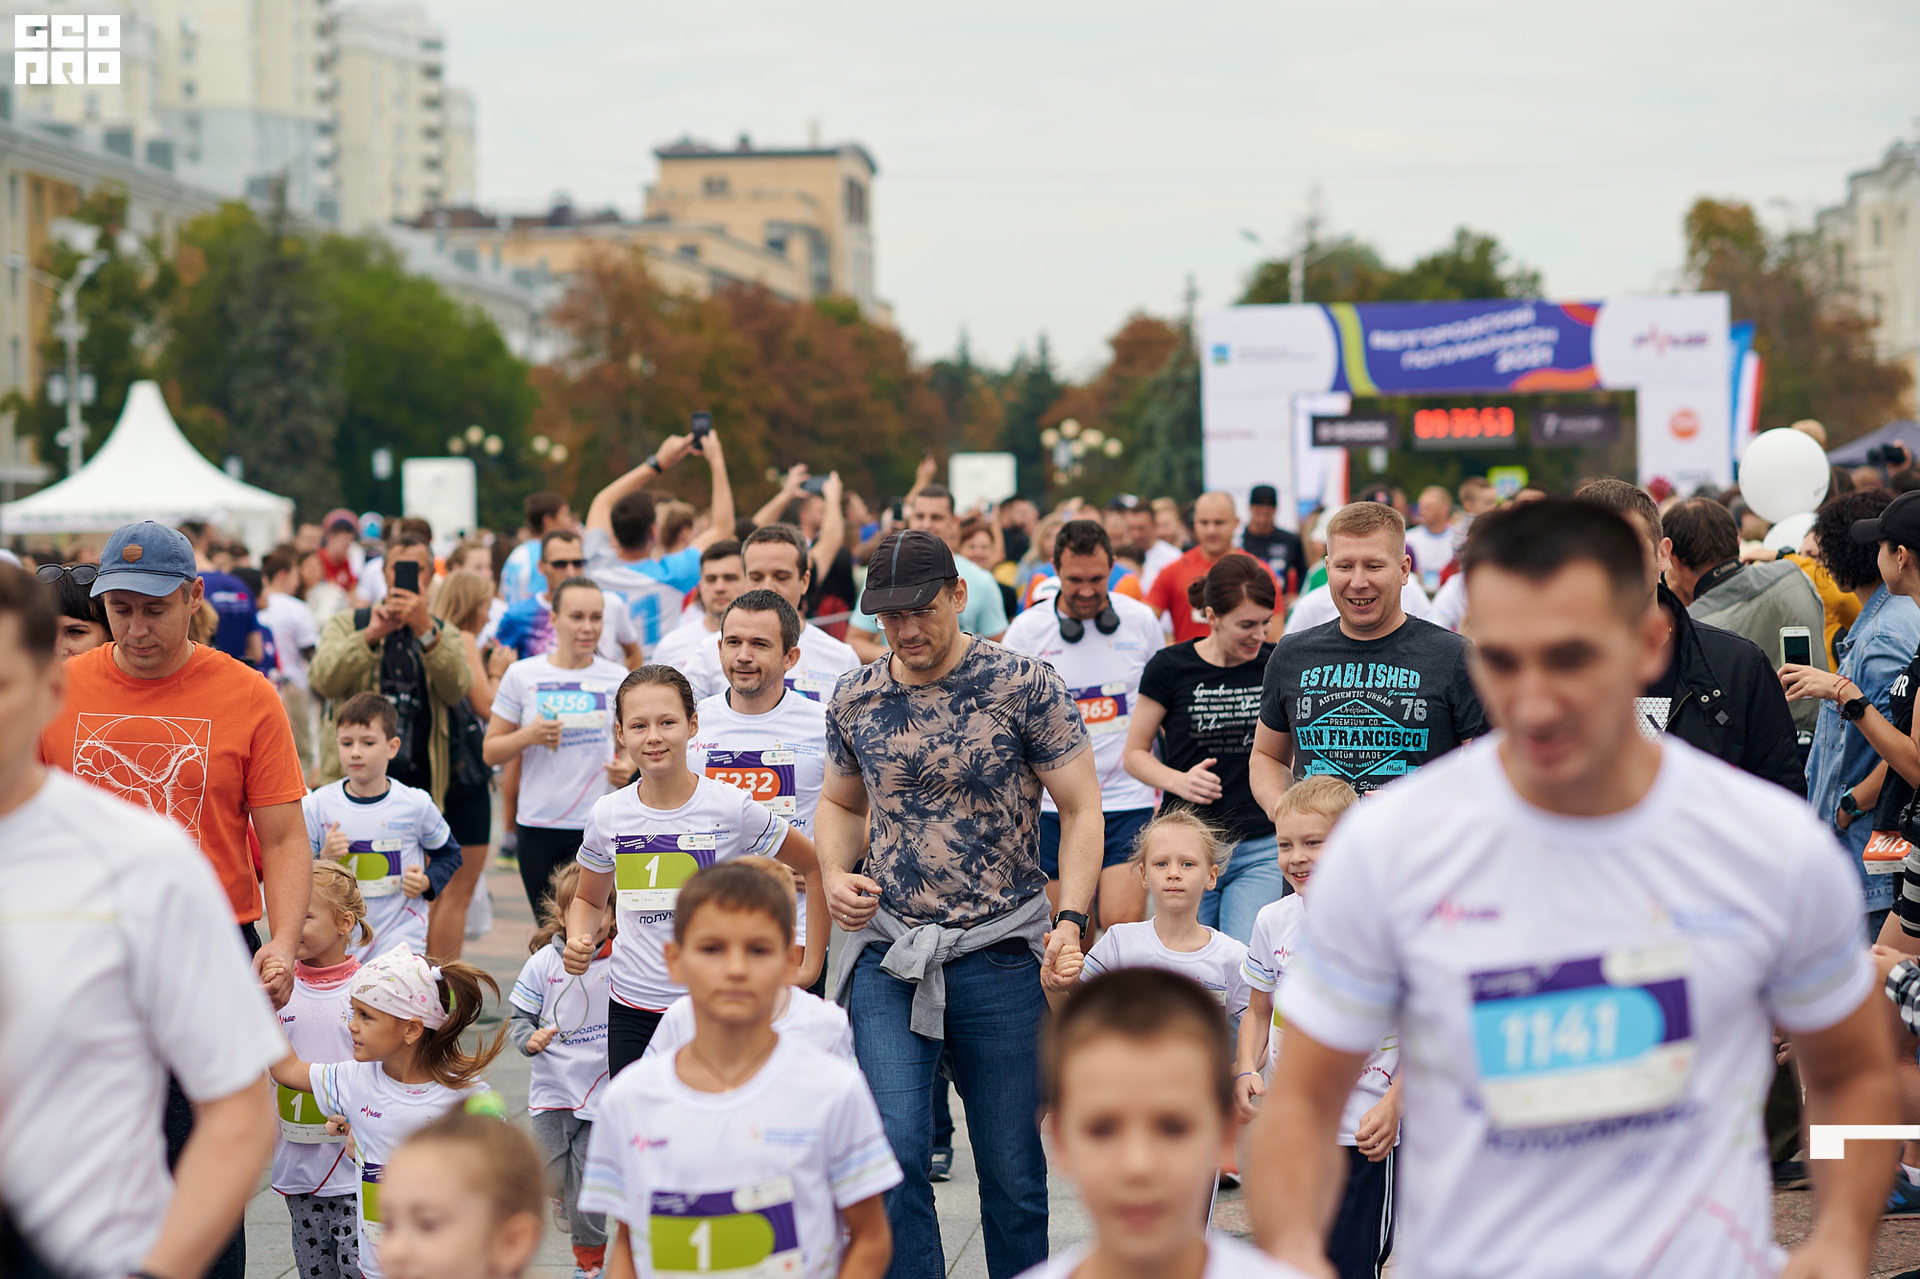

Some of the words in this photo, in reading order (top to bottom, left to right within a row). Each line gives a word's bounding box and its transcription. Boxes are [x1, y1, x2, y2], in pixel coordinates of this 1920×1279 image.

[1712, 561, 1738, 577] Canon
[1300, 663, 1421, 689] ESTABLISHED
[546, 695, 588, 711] 1356
[1296, 696, 1312, 720] 19
[1319, 690, 1364, 706] AUTHENTIC
[1366, 691, 1394, 708] URBAN
[1079, 699, 1114, 719] 365
[1340, 705, 1371, 716] Original
[1400, 698, 1427, 721] 76
[1329, 718, 1365, 726] PREMIUM
[1368, 718, 1381, 726] CO.
[1300, 730, 1324, 747] SAN
[1328, 730, 1421, 747] FRANCISCO
[1329, 751, 1354, 759] UNION
[1358, 751, 1382, 759] MADE
[644, 855, 659, 887] 1
[640, 911, 675, 924] ПОЛУМ
[1503, 1000, 1619, 1069] 1141
[291, 1093, 303, 1122] 1
[688, 1220, 711, 1271] 1
